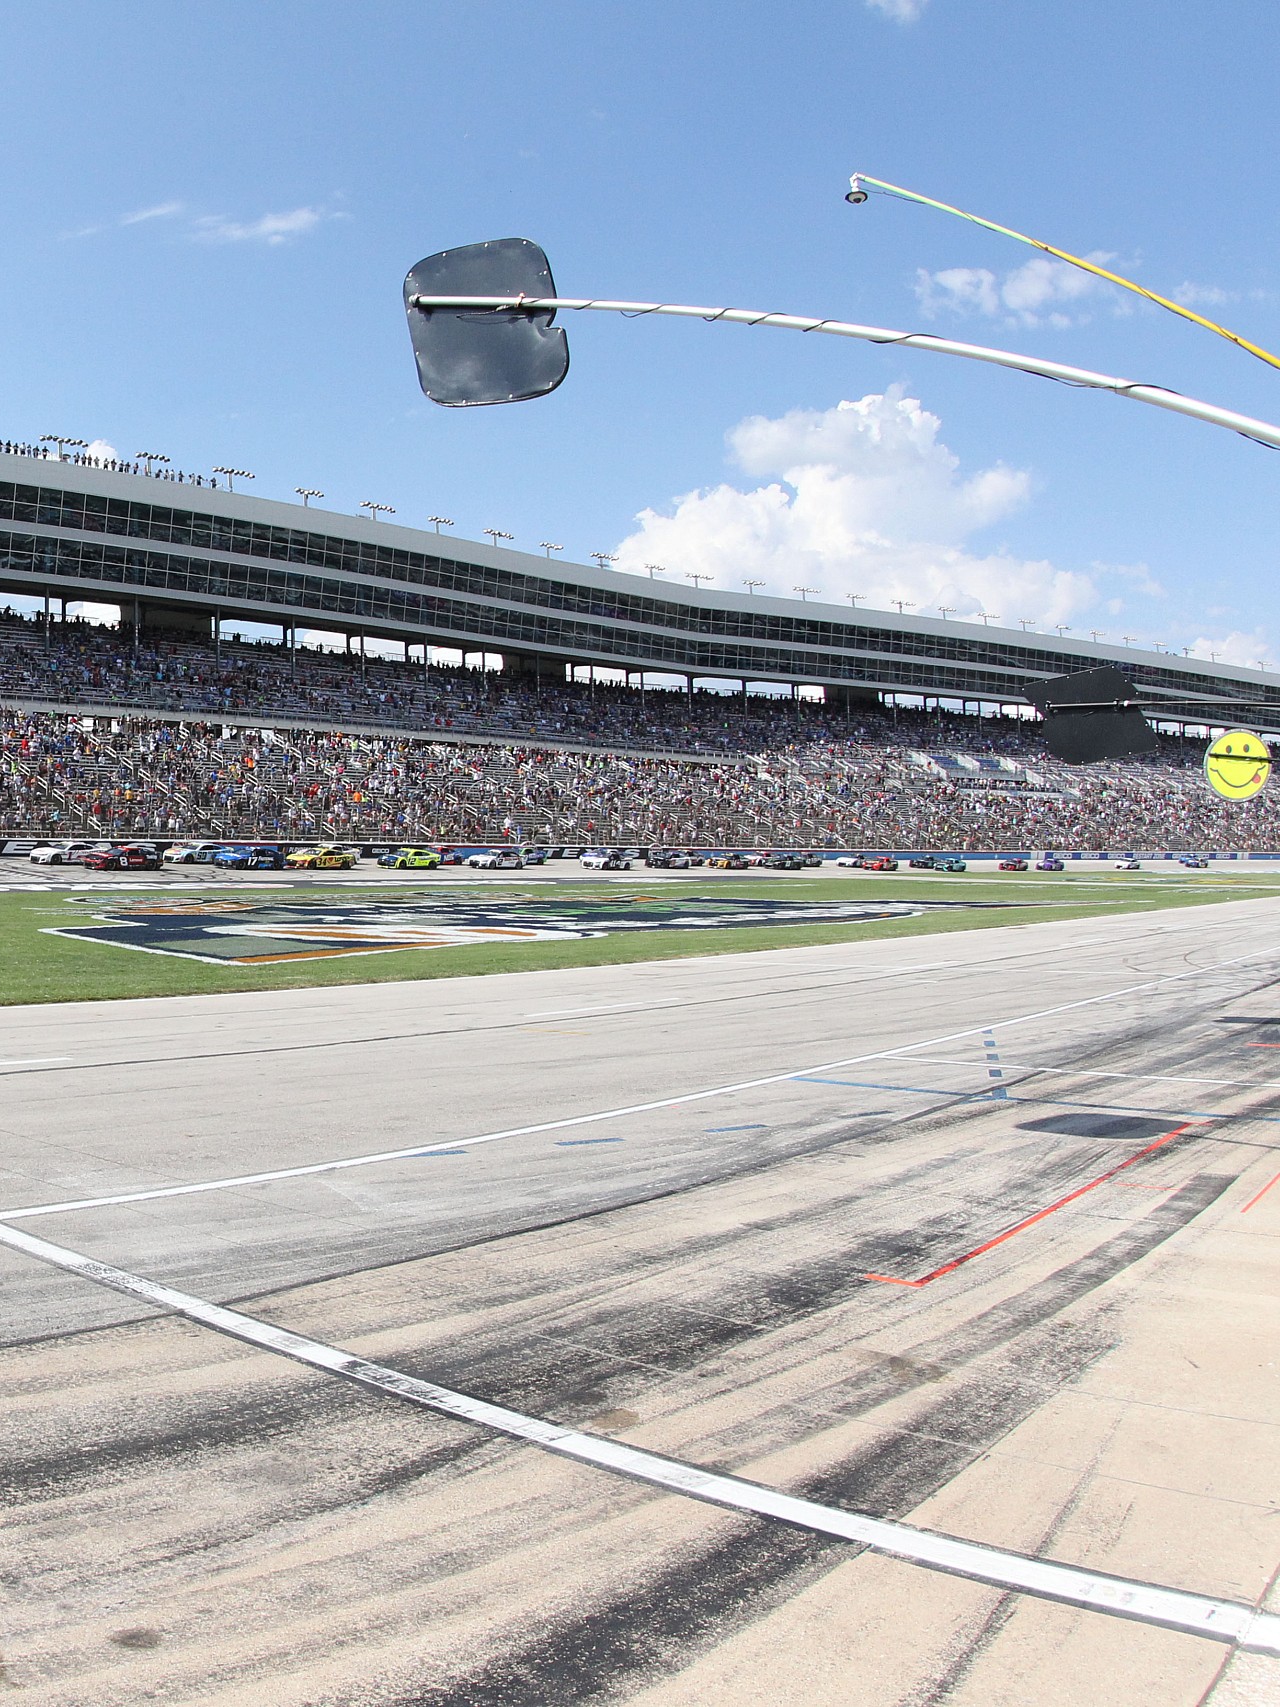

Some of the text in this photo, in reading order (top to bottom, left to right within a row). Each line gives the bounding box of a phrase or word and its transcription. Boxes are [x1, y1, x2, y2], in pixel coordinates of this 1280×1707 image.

[120, 856, 128, 867] 8
[247, 856, 258, 866] 17
[317, 857, 327, 866] 34
[408, 857, 417, 866] 12
